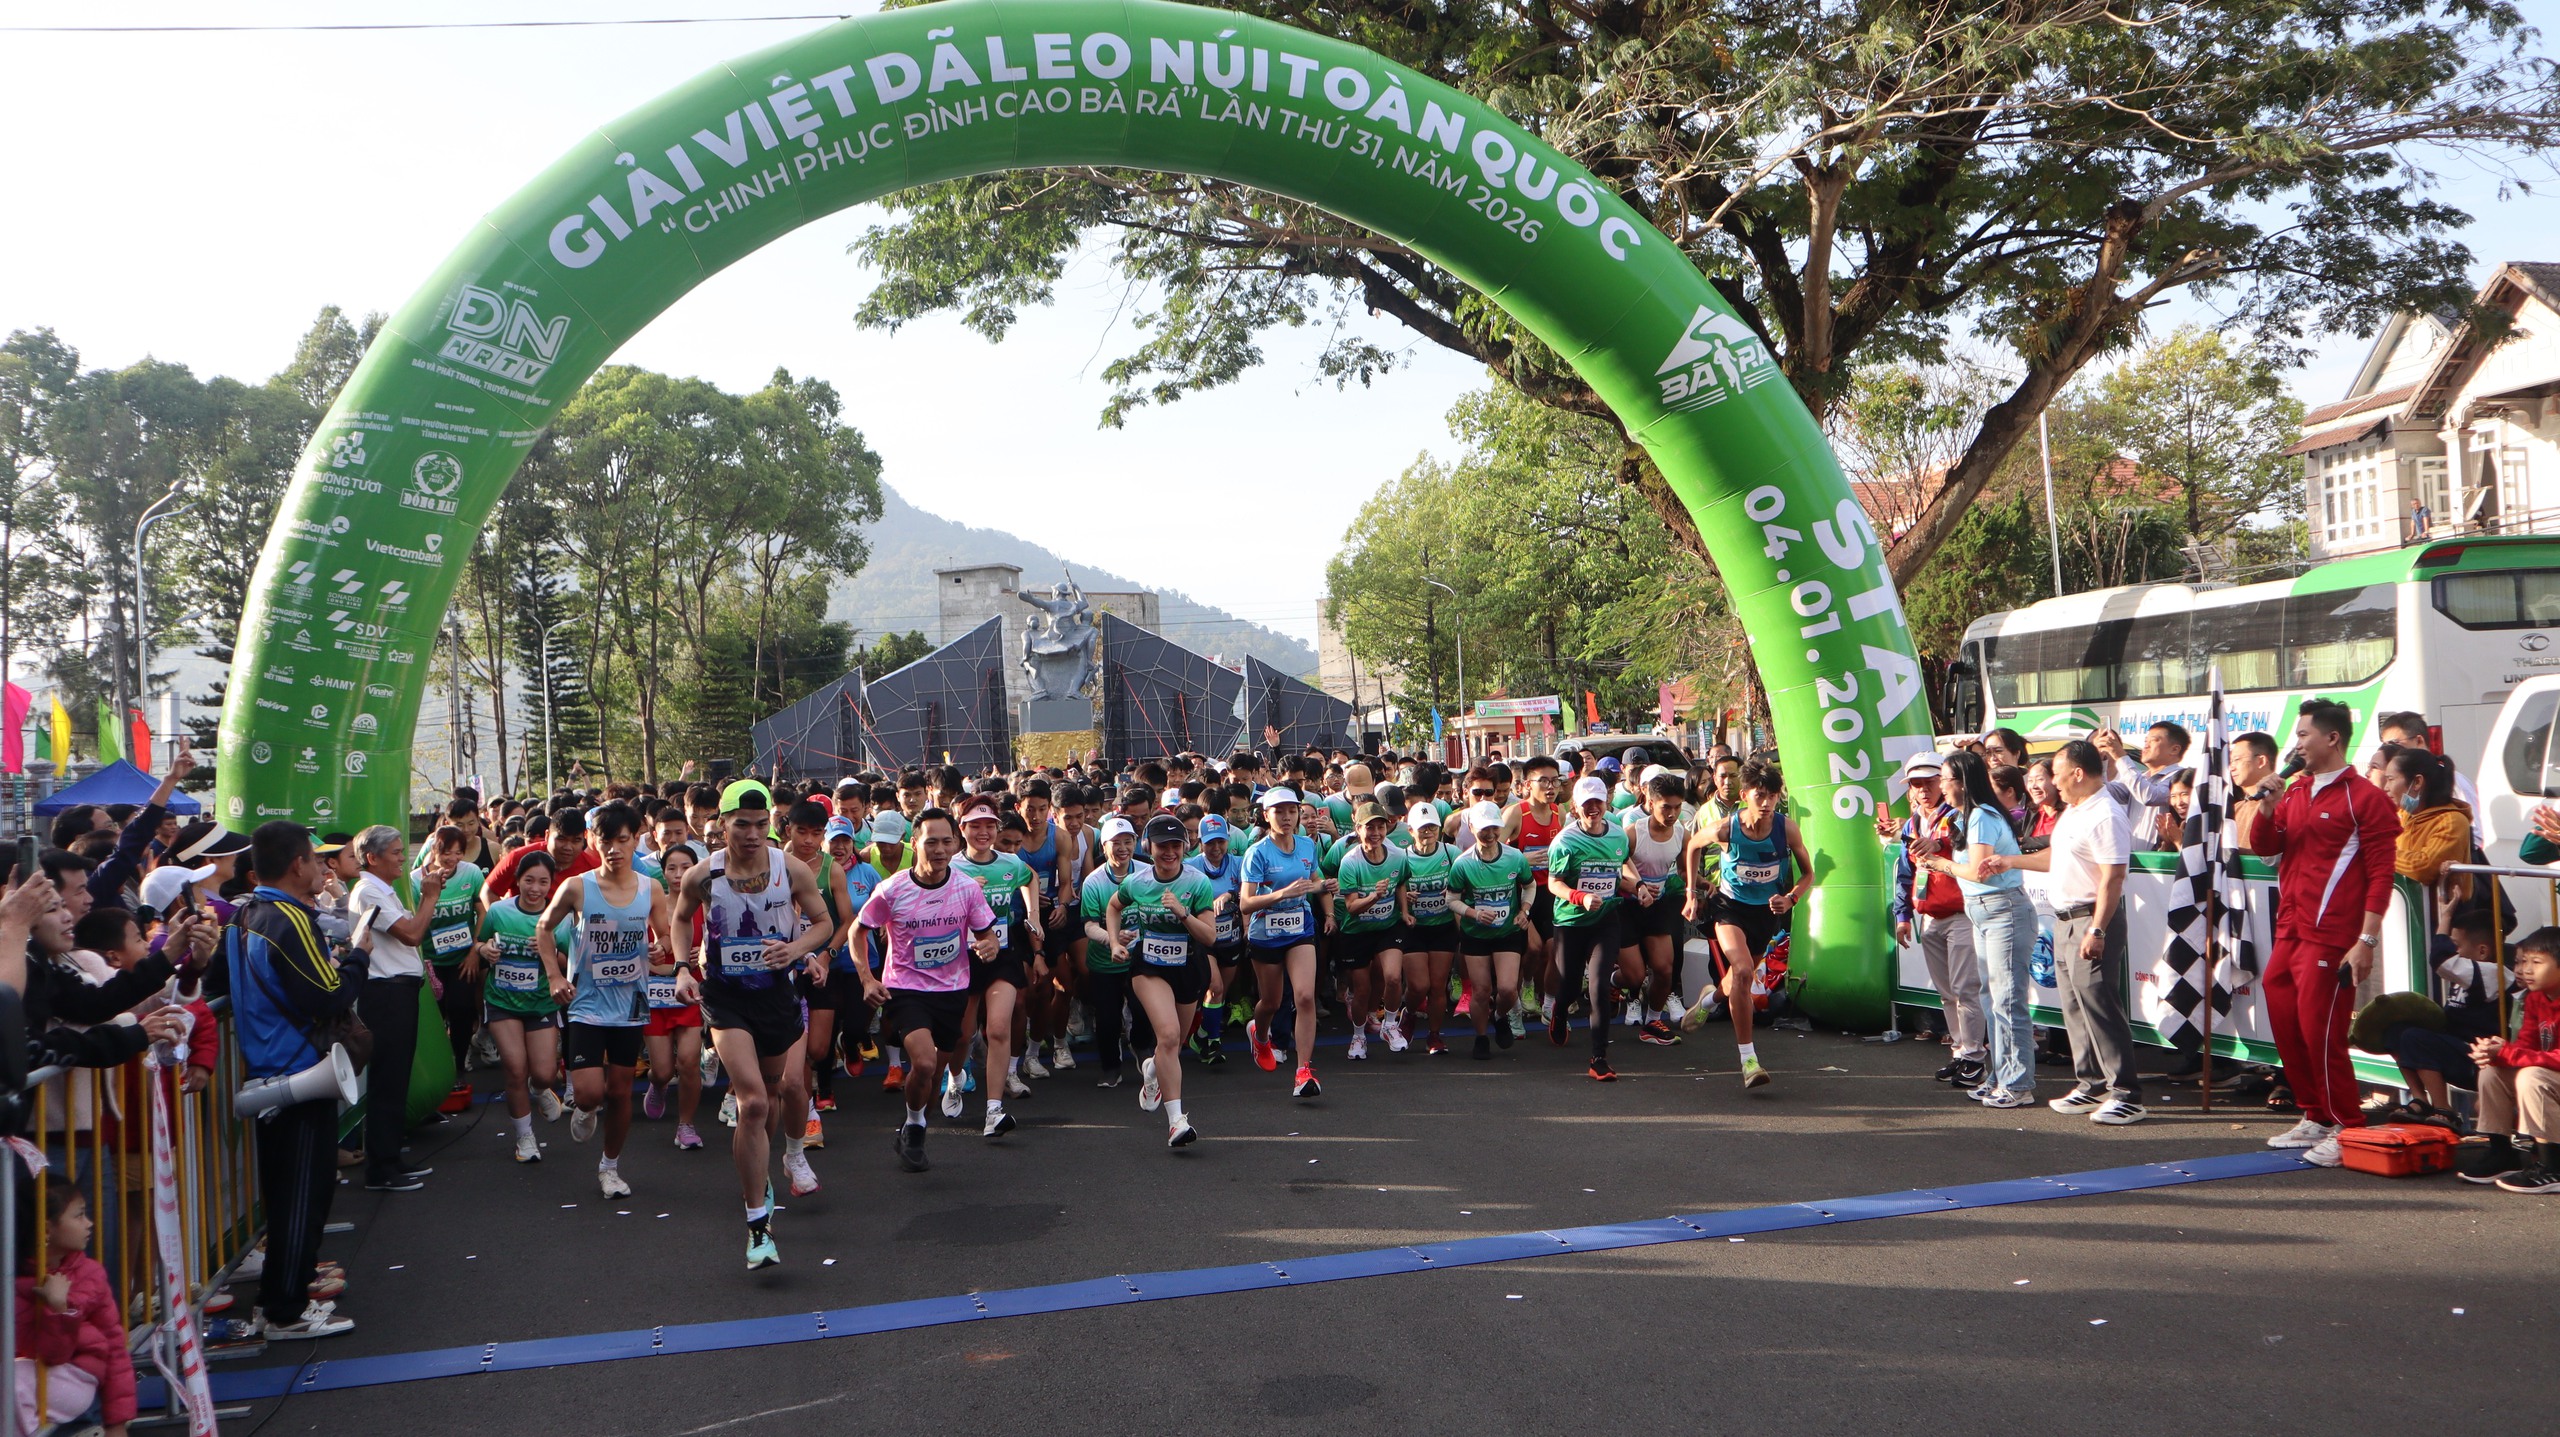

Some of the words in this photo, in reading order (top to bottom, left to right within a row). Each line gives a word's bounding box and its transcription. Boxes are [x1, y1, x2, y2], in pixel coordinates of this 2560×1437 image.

[548, 144, 706, 270] GIẢI
[692, 64, 857, 168] VIỆT
[864, 26, 983, 106] DÃ
[985, 31, 1132, 83] LEO
[1150, 29, 1269, 93] NÚI
[1279, 53, 1467, 156] TOÀN
[1471, 130, 1643, 262] QUỐC
[795, 121, 895, 182] PHỤC
[993, 86, 1073, 121] CAO
[1079, 80, 1128, 115] BÀ
[1200, 86, 1272, 132] LẦN
[1279, 108, 1351, 152] THỨ
[1349, 127, 1387, 171] 31,
[1391, 143, 1471, 199] NĂM
[1466, 184, 1546, 245] 2026
[321, 485, 355, 497] GROUP
[366, 538, 444, 563] Vietcombank
[328, 591, 363, 604] SONADEZI
[355, 622, 389, 638] SDV
[342, 643, 381, 656] AGRIBANK
[1744, 869, 1772, 878] 6918
[1581, 881, 1613, 891] F6626
[1415, 899, 1446, 909] F6600
[905, 917, 920, 930] NỘI
[921, 914, 942, 929] THẤT
[942, 911, 959, 926] YẾN
[1270, 916, 1301, 927] F6618
[436, 931, 468, 946] F6590
[589, 930, 619, 943] FROM
[622, 930, 645, 943] ZERO
[595, 942, 609, 954] TO
[612, 941, 637, 954] HERO
[923, 943, 955, 959] 6760
[1147, 943, 1182, 956] F6619
[731, 951, 762, 963] 687
[498, 968, 535, 981] F6584
[601, 963, 636, 976] 6820
[649, 988, 676, 998] F651
